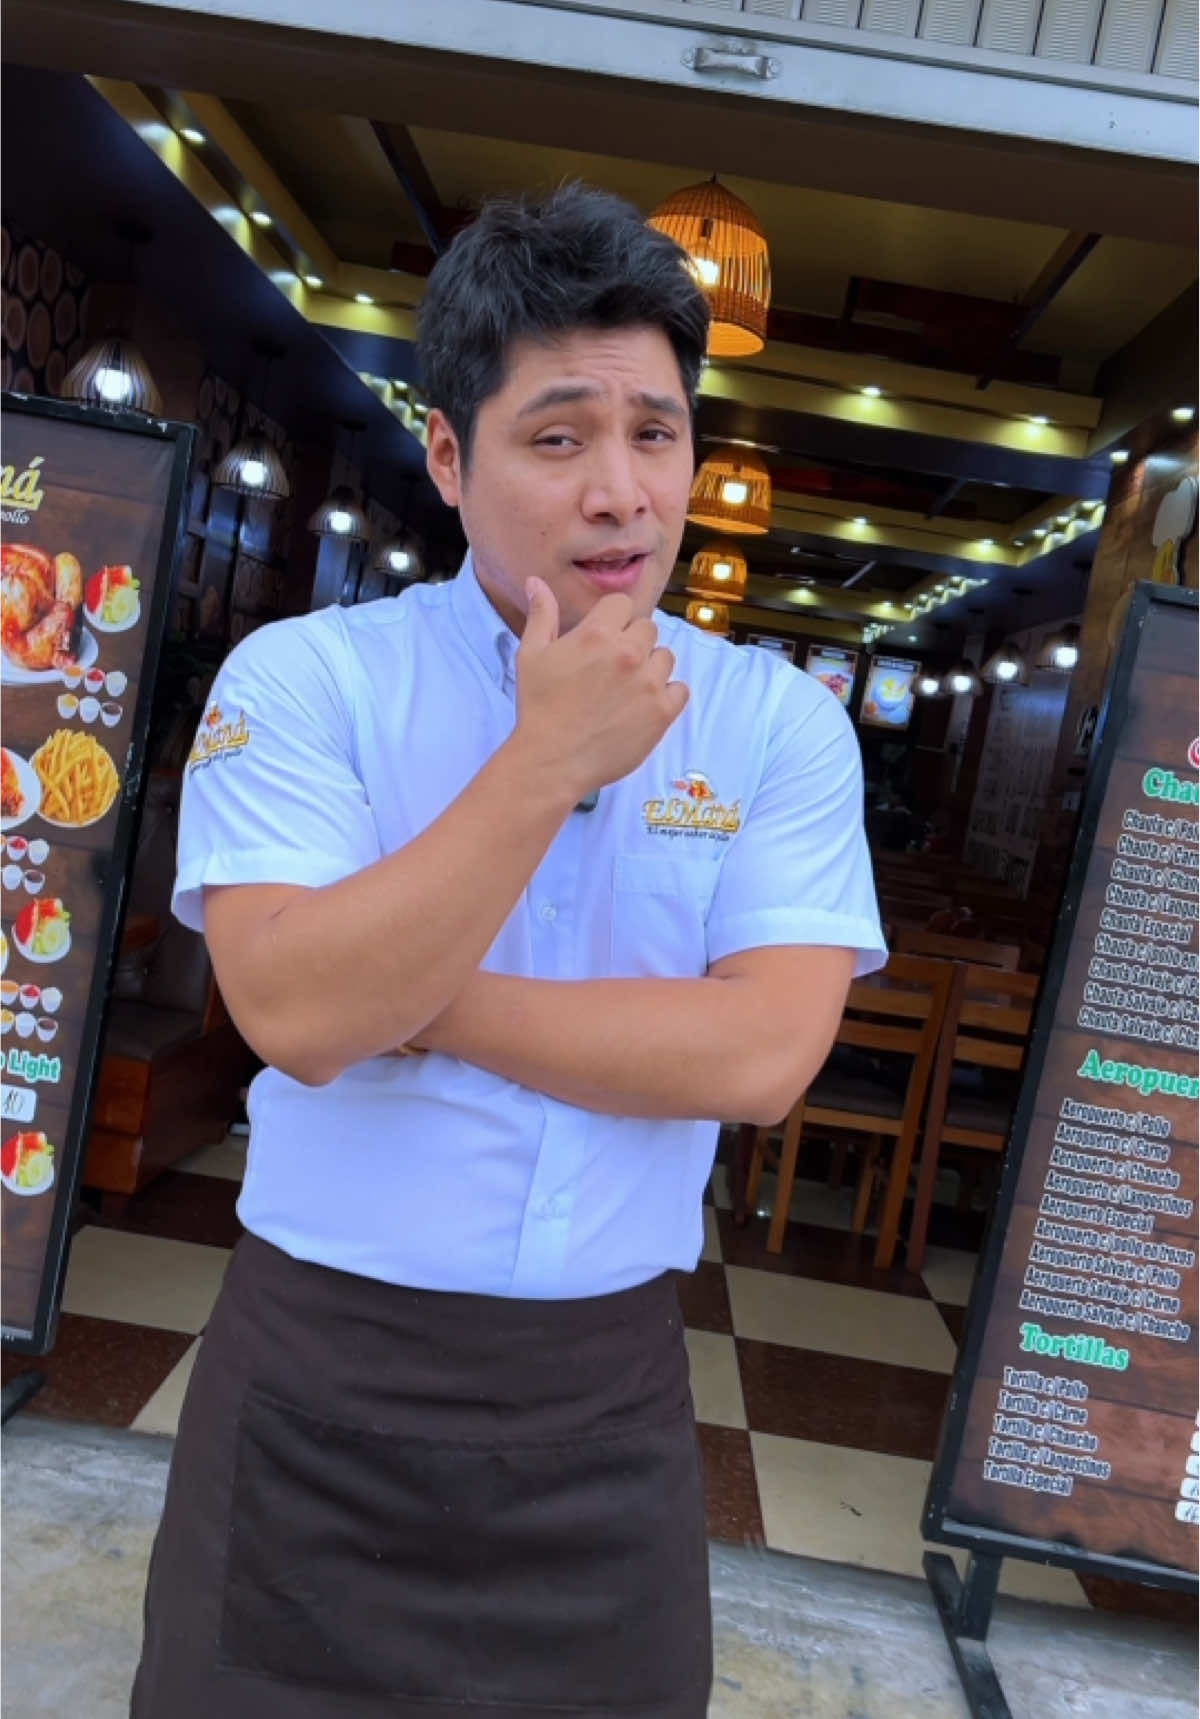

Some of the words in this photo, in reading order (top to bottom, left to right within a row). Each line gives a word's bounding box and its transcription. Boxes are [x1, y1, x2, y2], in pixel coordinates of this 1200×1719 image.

[1142, 768, 1199, 806] Cha
[8, 1049, 60, 1083] Light
[1020, 1322, 1129, 1370] Tortillas
